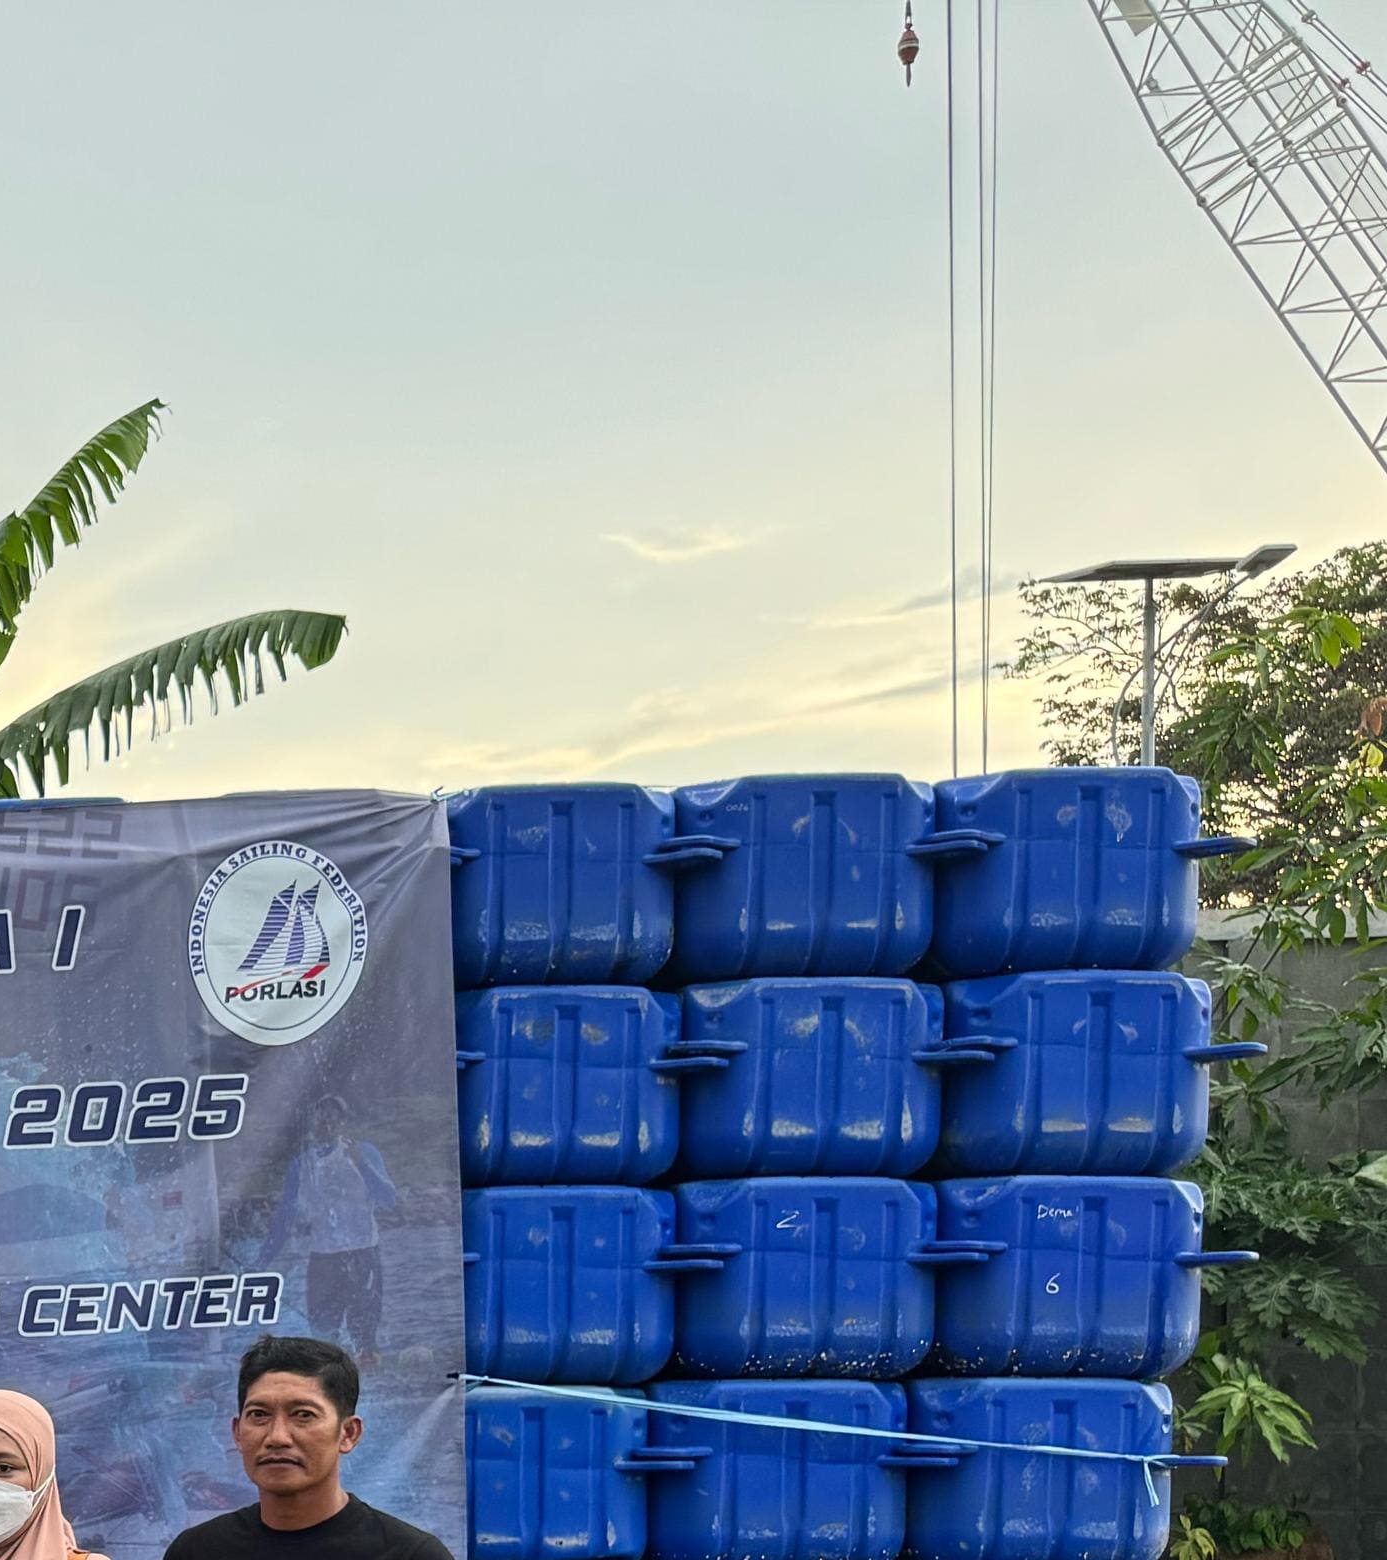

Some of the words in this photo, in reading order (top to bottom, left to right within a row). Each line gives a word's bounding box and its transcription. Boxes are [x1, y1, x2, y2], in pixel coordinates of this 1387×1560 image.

[52, 905, 86, 971] I
[191, 869, 228, 976] INDONESIA
[228, 842, 307, 869] SAILING
[312, 855, 366, 963] FEDERATION
[224, 979, 326, 1003] PORLASI
[3, 1073, 249, 1149] 2025
[18, 1272, 284, 1337] CENTER
[1045, 1272, 1061, 1294] 6
